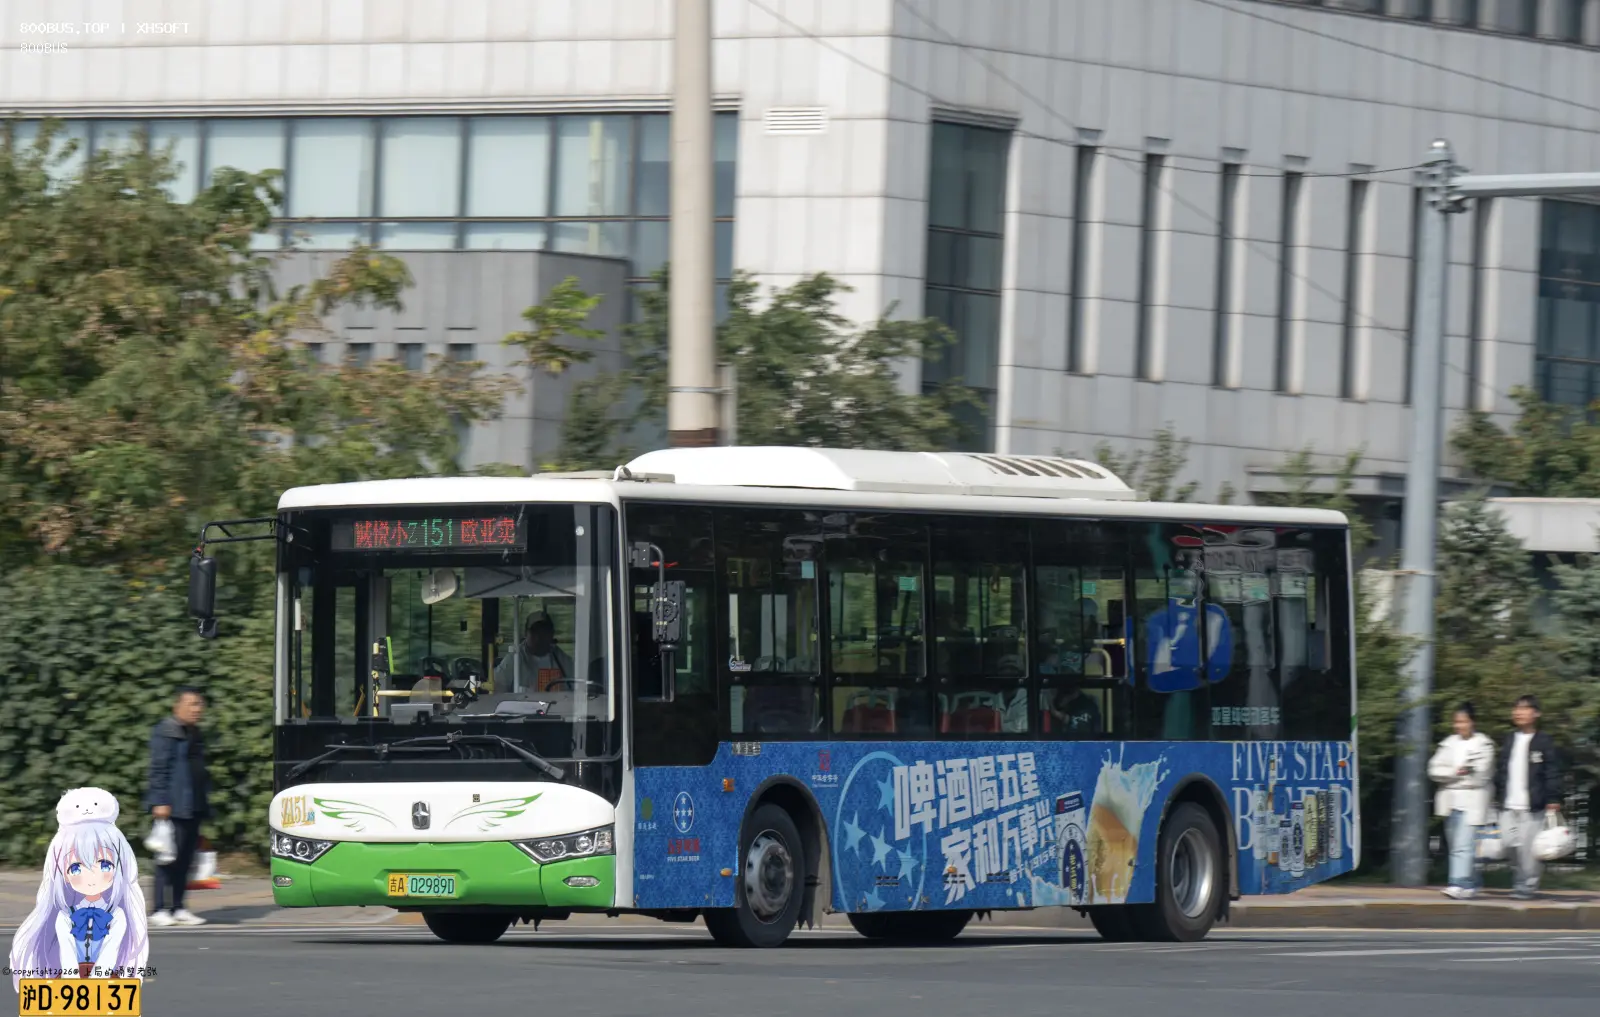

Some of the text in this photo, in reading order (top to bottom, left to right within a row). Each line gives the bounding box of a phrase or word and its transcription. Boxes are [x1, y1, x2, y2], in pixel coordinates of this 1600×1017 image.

[408, 518, 453, 546] Z151
[461, 517, 516, 544] 欧亚卖
[1231, 741, 1353, 781] FIVE STAR
[893, 751, 1041, 841] 啤酒喝五星
[1232, 786, 1353, 850] BR
[940, 798, 1055, 906] 家和万事兴
